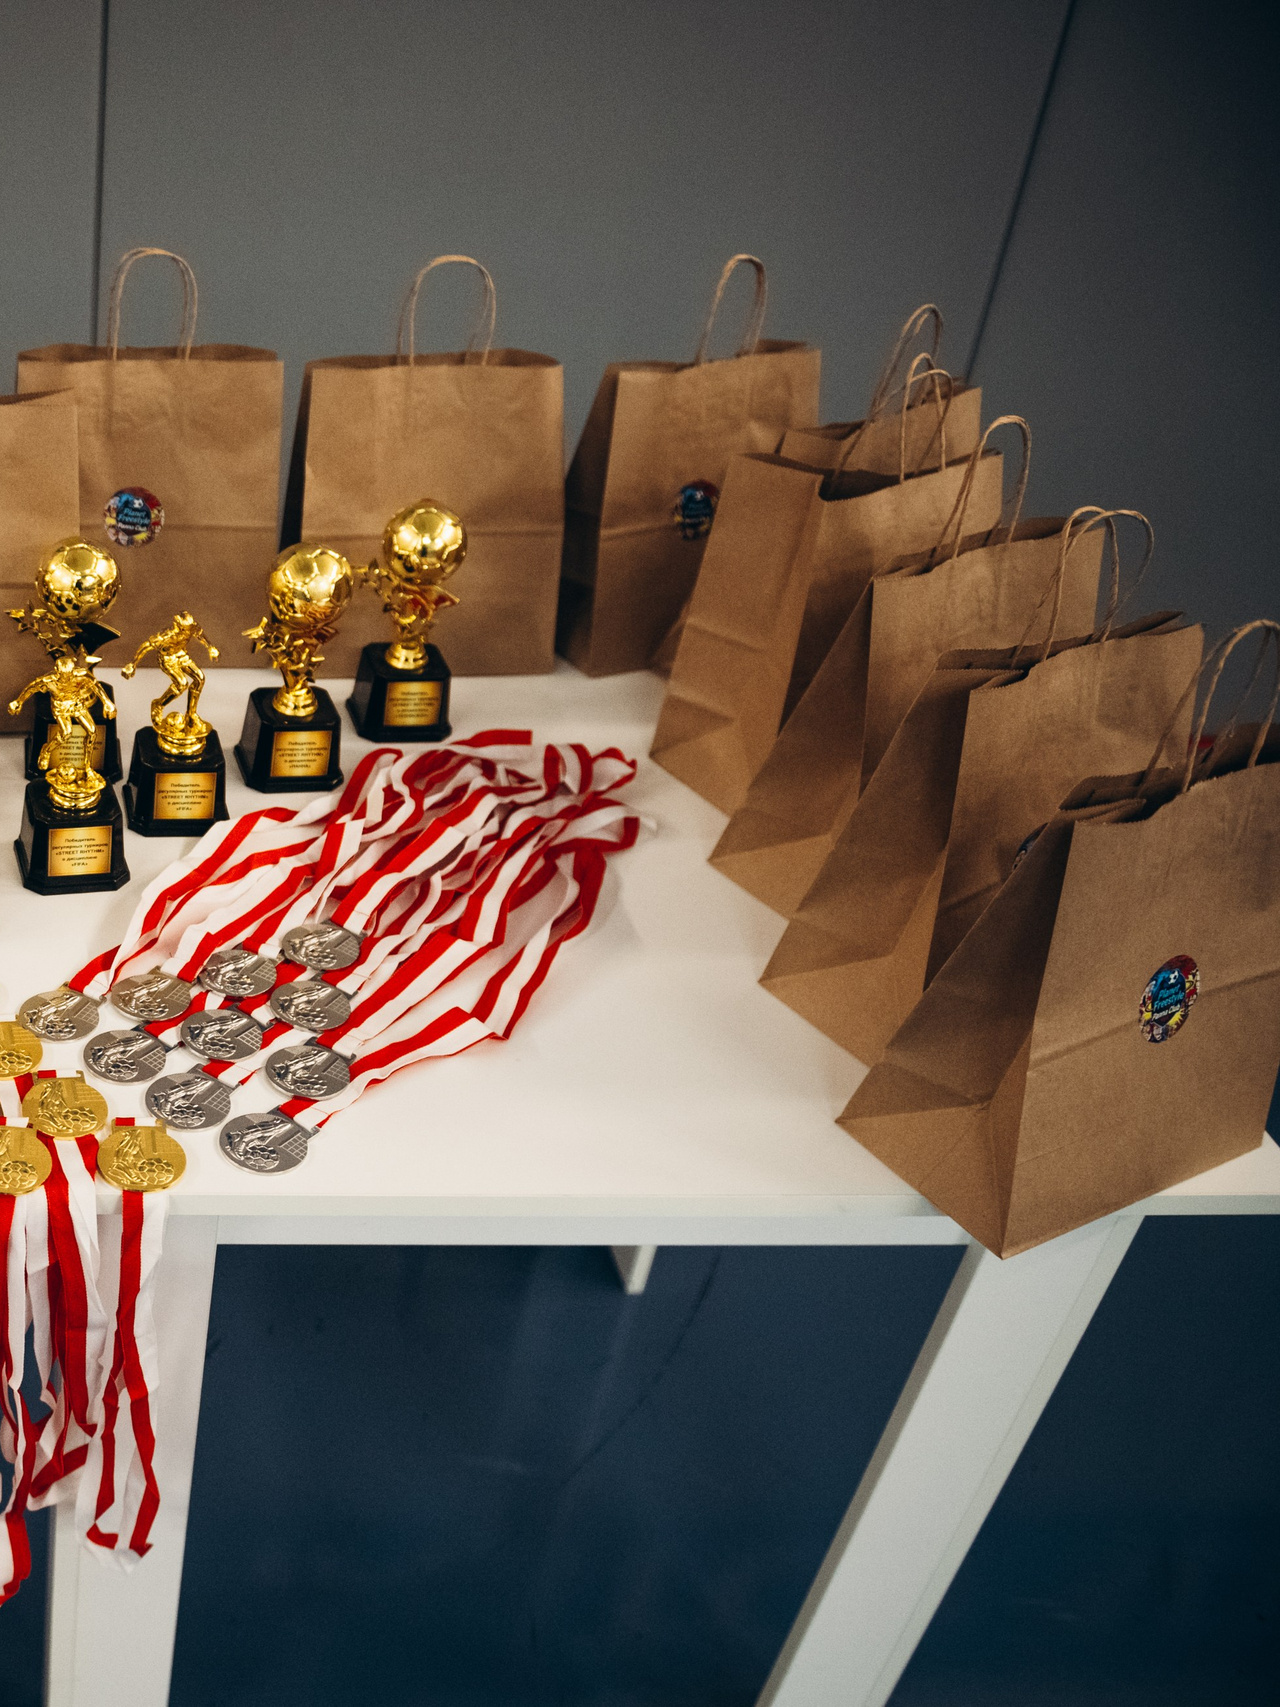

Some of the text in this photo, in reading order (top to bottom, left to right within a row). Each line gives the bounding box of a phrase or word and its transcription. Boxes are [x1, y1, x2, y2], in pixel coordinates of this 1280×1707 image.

[123, 507, 147, 517] Planet
[1153, 991, 1186, 1013] Freestyle
[1158, 984, 1181, 1002] Planet
[1151, 1003, 1181, 1021] Panna Club
